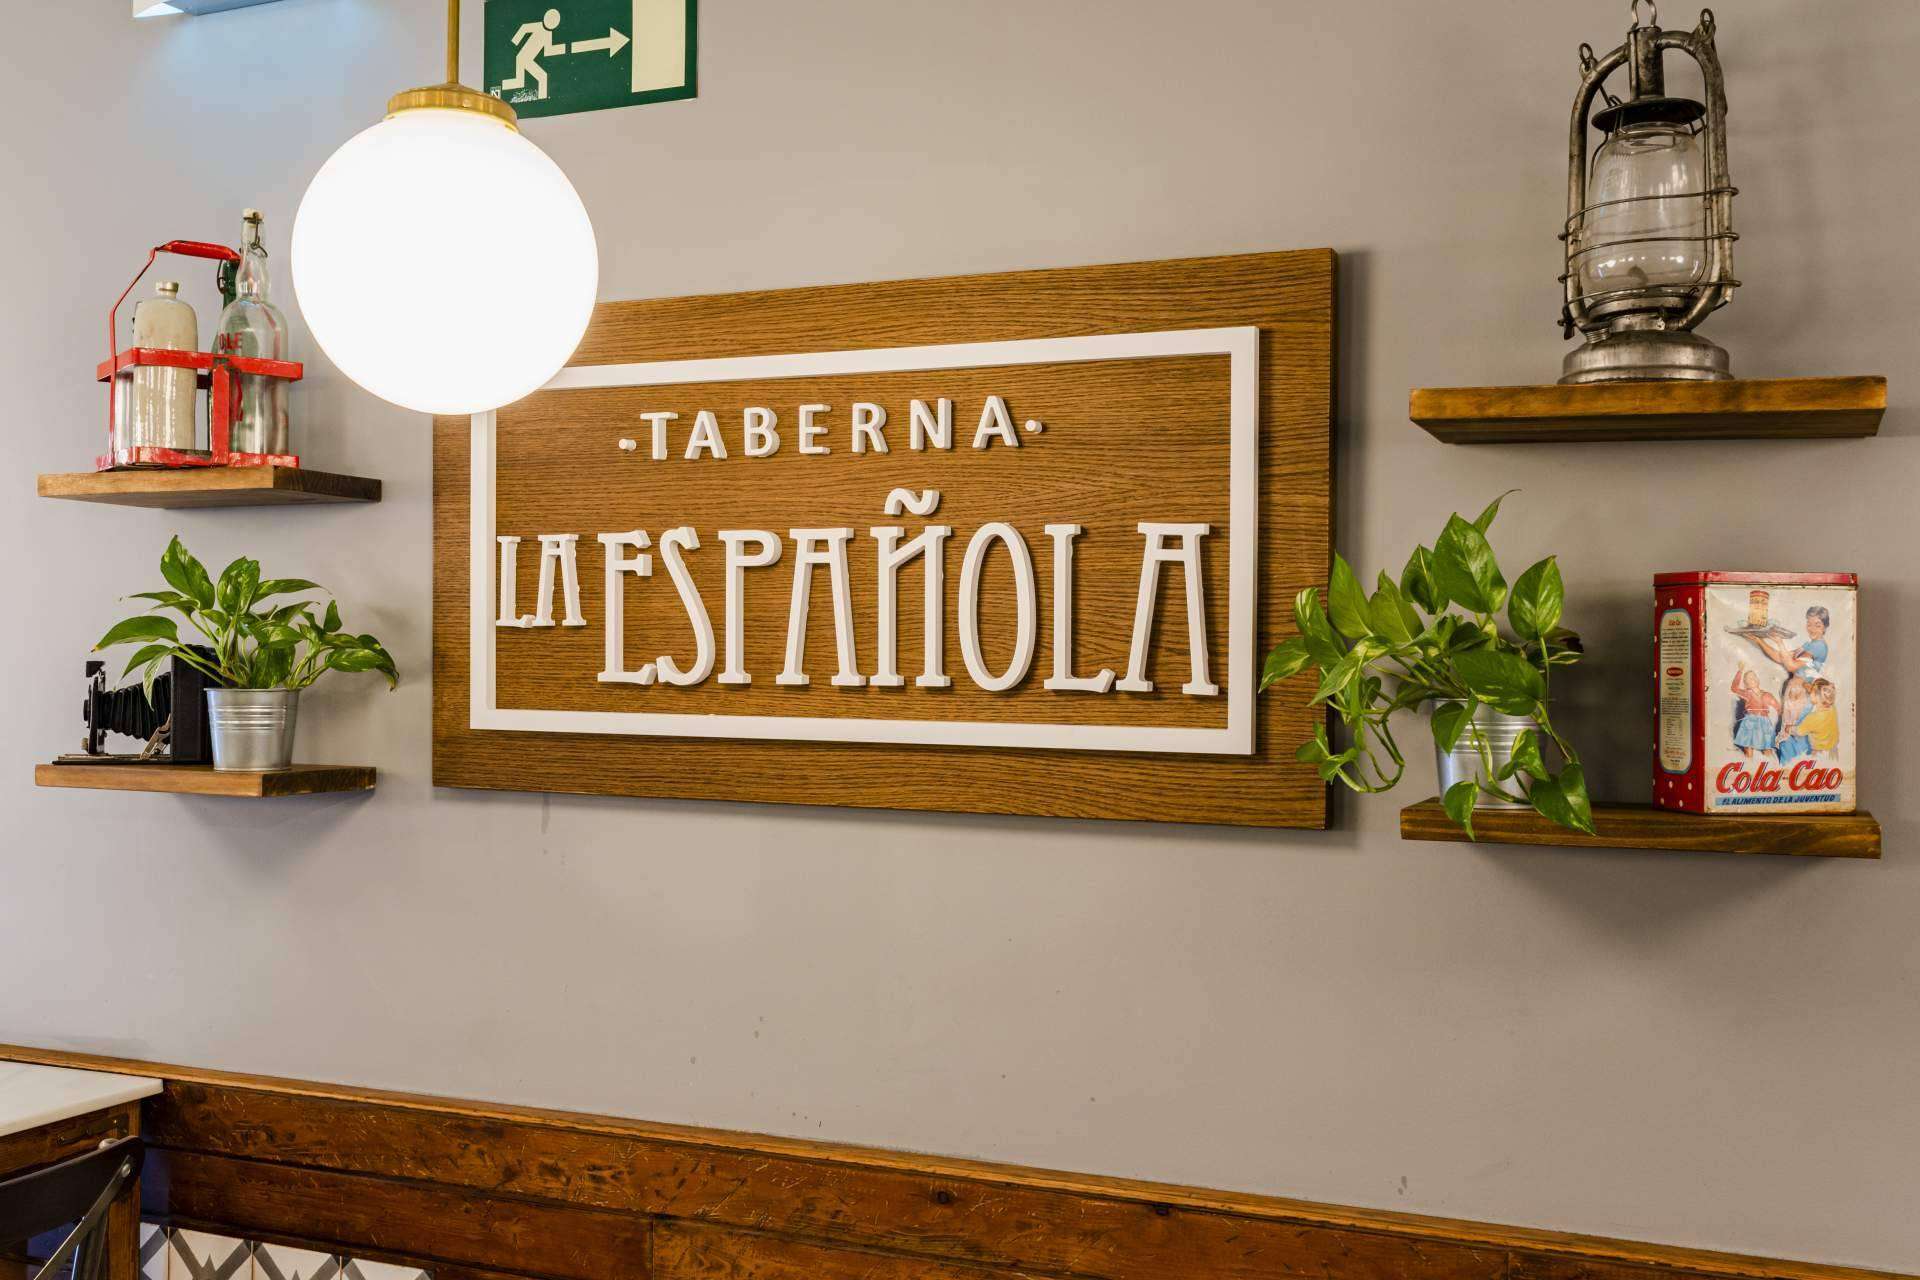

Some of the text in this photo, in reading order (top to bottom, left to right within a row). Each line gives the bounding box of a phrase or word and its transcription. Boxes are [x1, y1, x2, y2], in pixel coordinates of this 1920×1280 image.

[495, 487, 1220, 696] LA ESPAÑOLA
[1732, 796, 1772, 805] ALIMENTO
[1772, 796, 1784, 804] DE
[1784, 796, 1793, 804] LA
[1794, 794, 1836, 803] JUVENTUD
